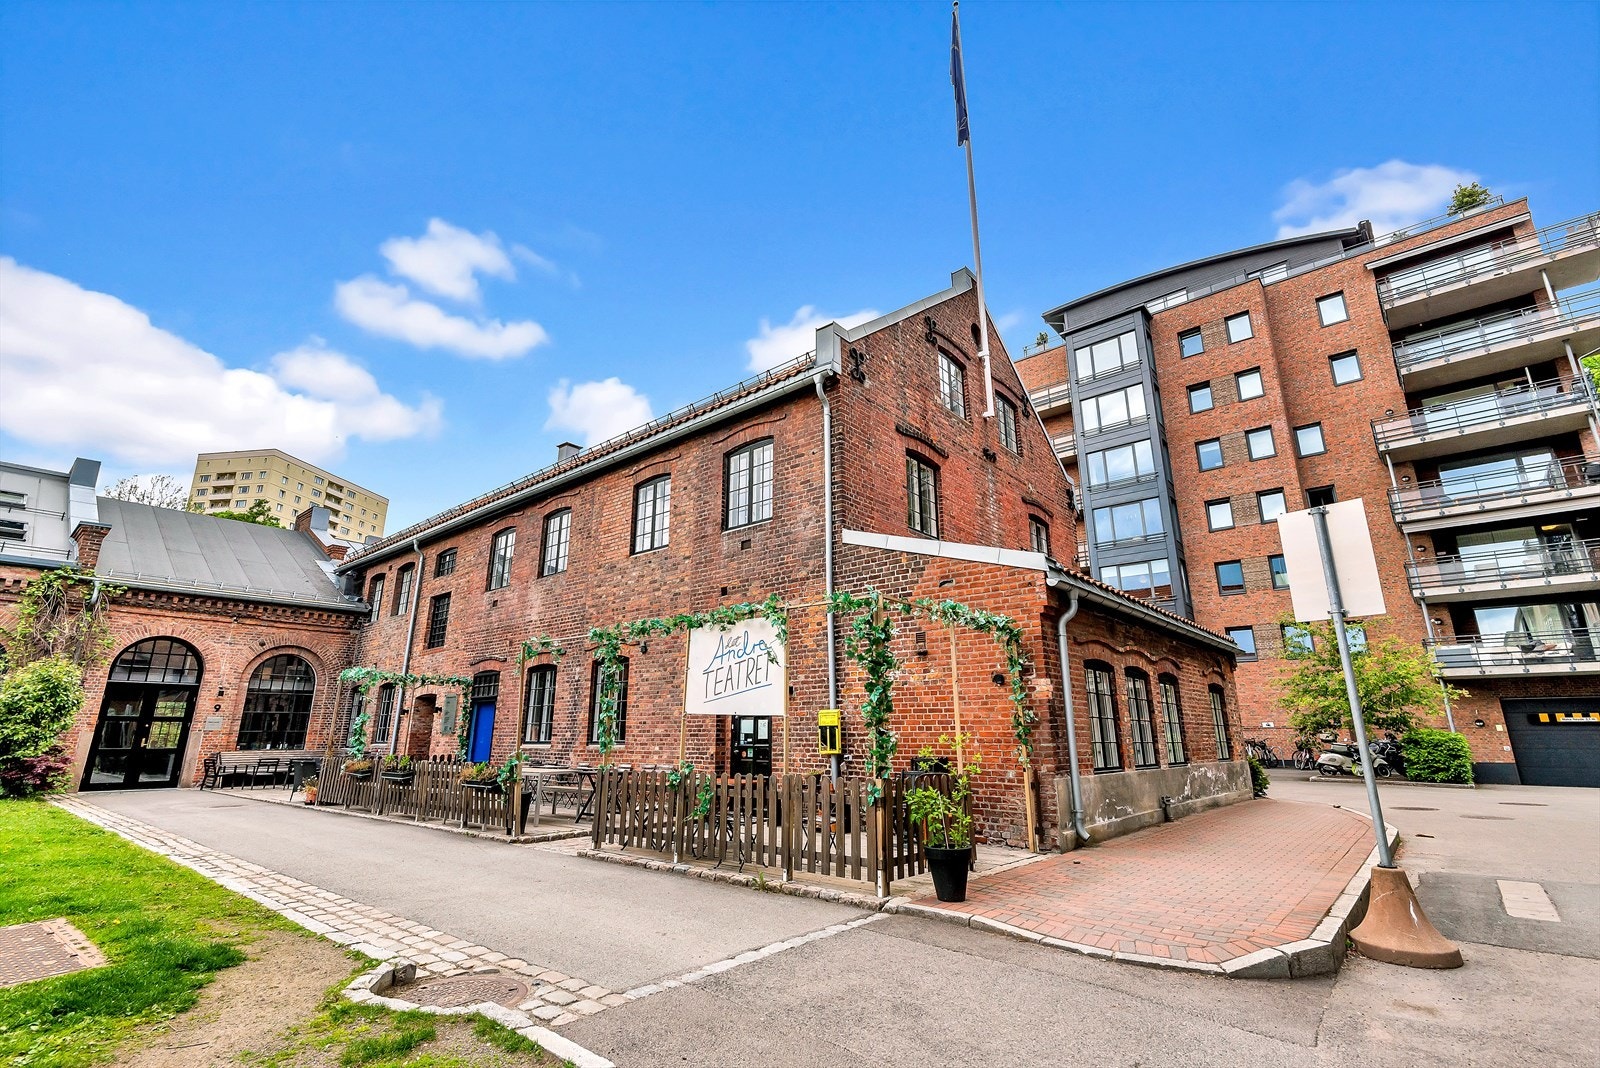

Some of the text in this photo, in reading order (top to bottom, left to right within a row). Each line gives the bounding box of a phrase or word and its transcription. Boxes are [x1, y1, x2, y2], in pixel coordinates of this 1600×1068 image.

[703, 630, 772, 672] Andre
[702, 652, 772, 699] TEATRET
[214, 704, 221, 712] 9
